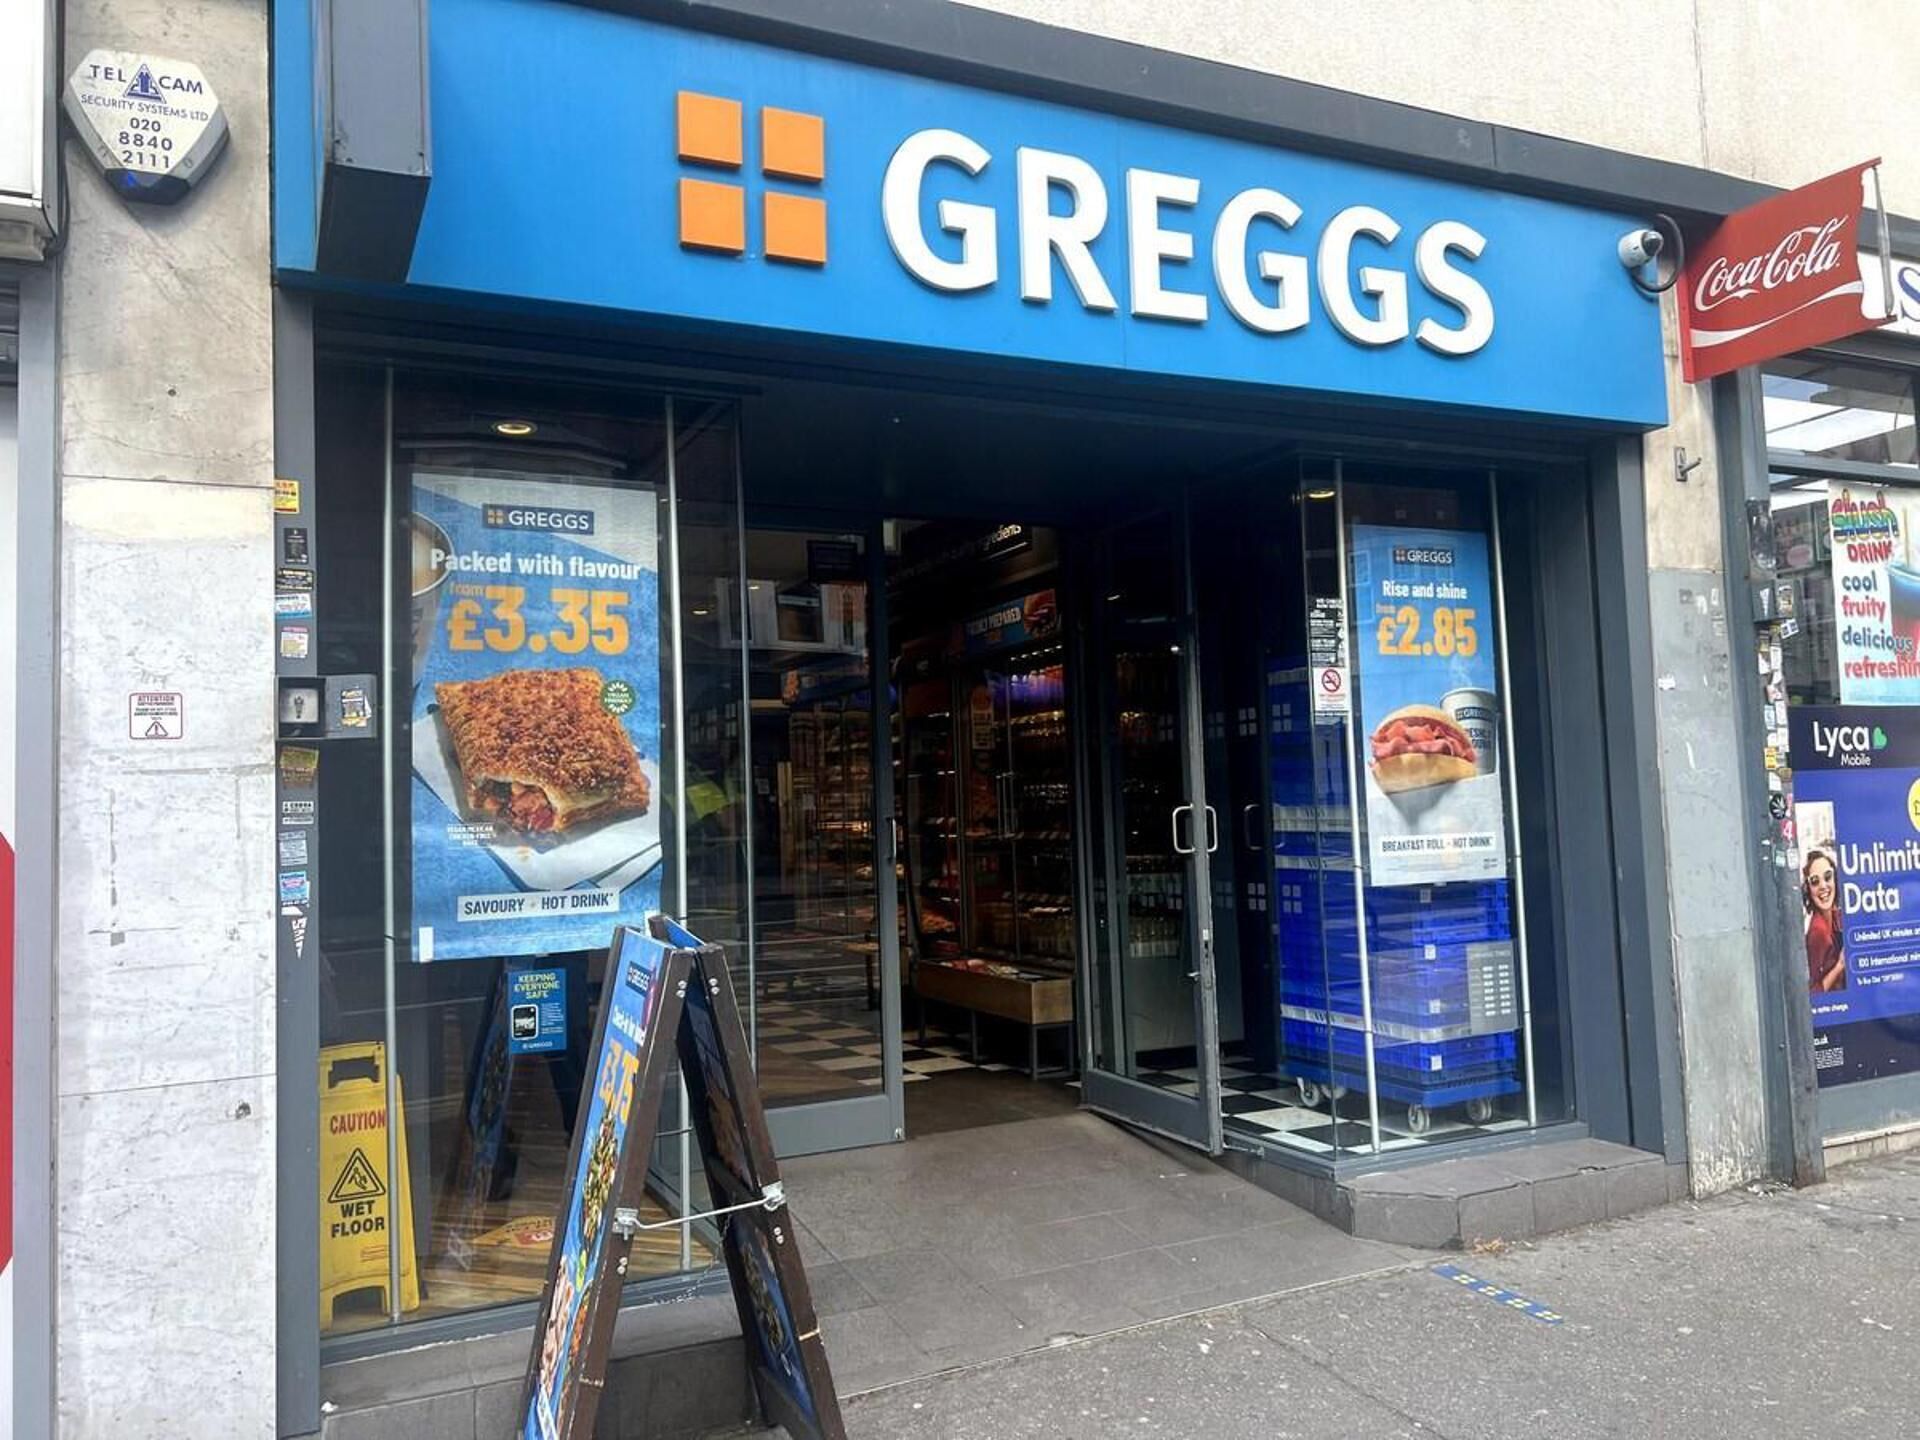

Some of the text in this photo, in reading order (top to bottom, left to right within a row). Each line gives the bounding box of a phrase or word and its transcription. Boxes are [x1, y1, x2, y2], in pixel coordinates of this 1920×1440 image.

[90, 64, 203, 95] TEL CAM
[80, 94, 209, 122] SECURITY SYSTEMS LTD
[130, 117, 161, 132] 020
[118, 131, 173, 151] 8840
[122, 150, 170, 169] 2111
[881, 127, 1496, 357] GREGGS
[1695, 214, 1848, 312] Coca-Cola
[508, 509, 589, 531] GREGGS
[1407, 549, 1453, 565] GREGGS
[1847, 540, 1893, 564] DRINK
[431, 548, 641, 580] Packed with flavour
[1382, 580, 1468, 600] Rise and shine
[1841, 570, 1878, 592] cool
[1841, 594, 1886, 623] fruity
[447, 585, 630, 656] £3.35
[1377, 604, 1478, 658] £2.85
[1841, 625, 1914, 653] delicious
[1813, 721, 1870, 758] Lyca
[1840, 754, 1872, 767] Mobile
[1382, 839, 1424, 853] BREAKFAST
[1426, 839, 1445, 850] ROLL
[1452, 837, 1467, 848] HOT
[1840, 839, 1920, 876] Unlimit
[464, 898, 525, 916] SAVOURY
[541, 895, 569, 910] HOT
[1843, 880, 1900, 915] Data
[514, 980, 560, 992] EVERYONE
[518, 972, 556, 983] KEEPING
[525, 990, 550, 1000] SAFE
[330, 1109, 386, 1136] CAUTION
[340, 1200, 376, 1219] WET
[331, 1216, 385, 1239] FLOOR
